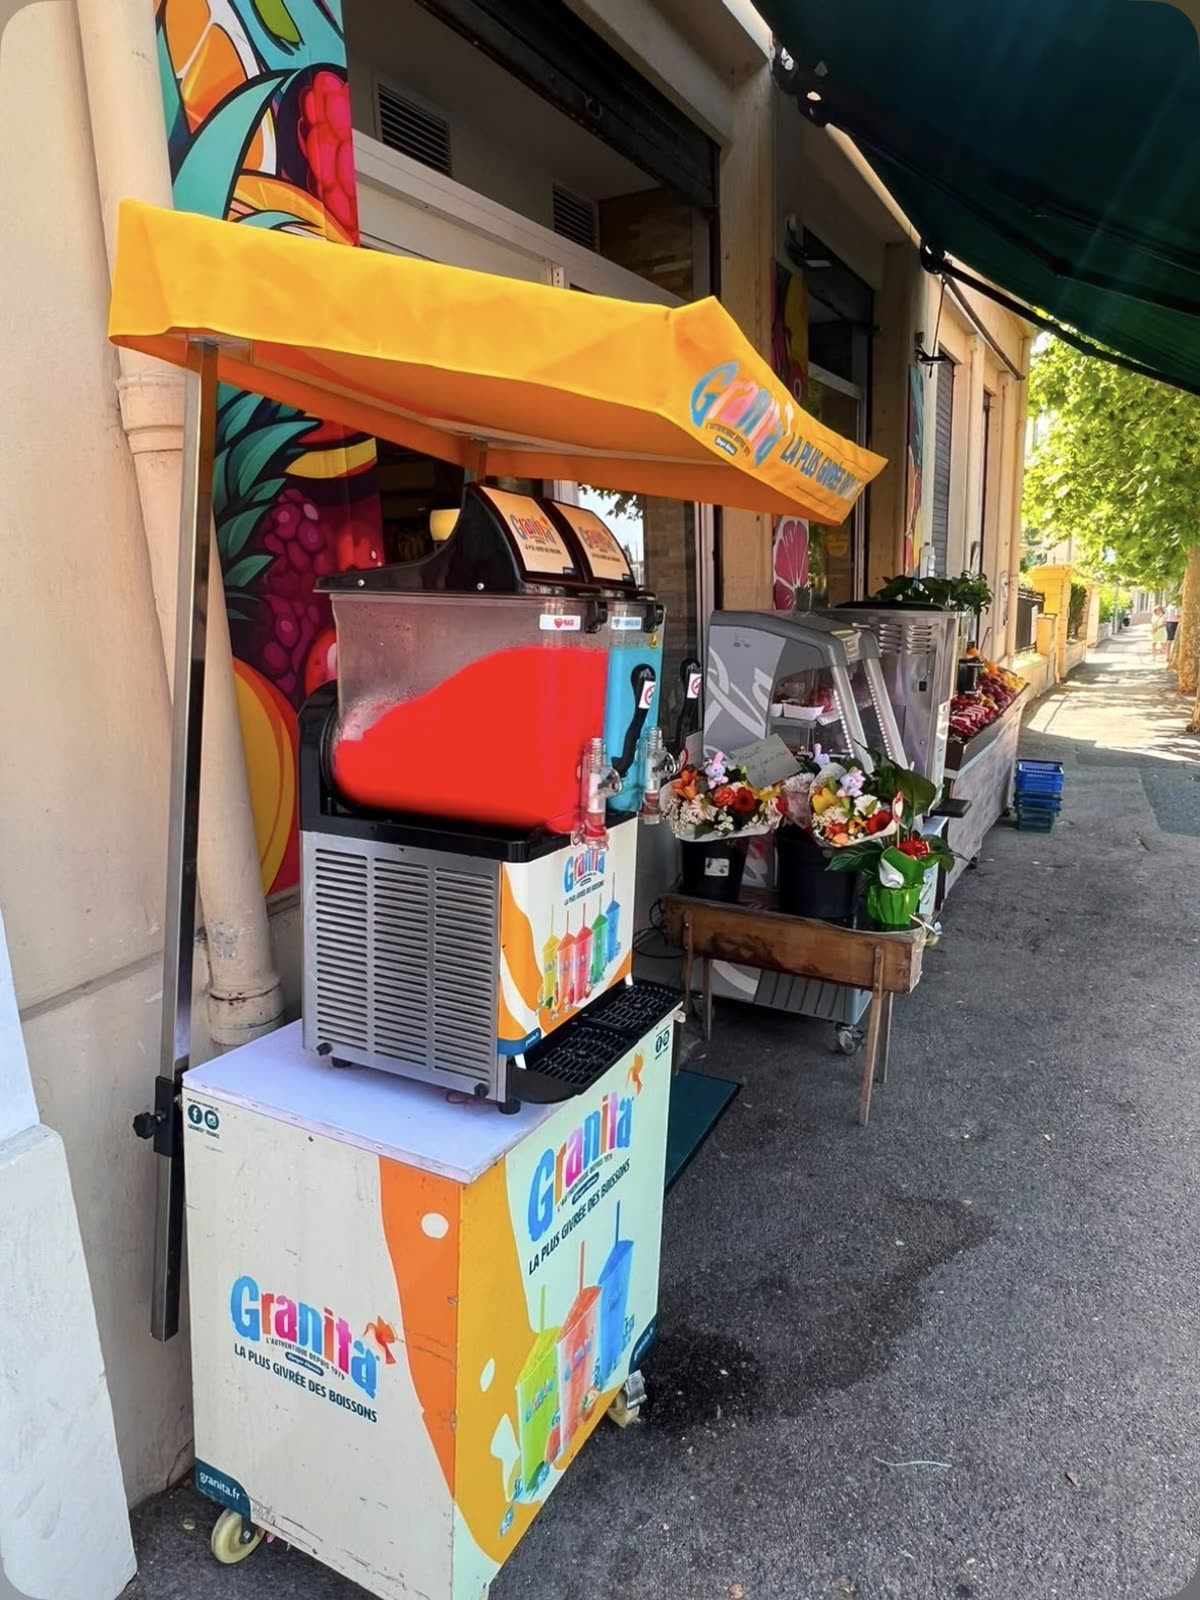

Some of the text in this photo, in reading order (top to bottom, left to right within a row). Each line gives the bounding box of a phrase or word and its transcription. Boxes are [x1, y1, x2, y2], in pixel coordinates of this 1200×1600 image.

[528, 1091, 632, 1242] Granita
[529, 1253, 540, 1275] LA
[541, 1231, 560, 1262] PLUS
[587, 1189, 601, 1212] DES
[230, 1275, 378, 1399] Granita
[234, 1343, 247, 1359] LA
[248, 1349, 271, 1371] PLUS
[272, 1362, 307, 1389] GIVRÉE
[308, 1379, 327, 1399] DES
[328, 1389, 378, 1423] BOISSONS
[199, 1471, 240, 1501] granita.fr
